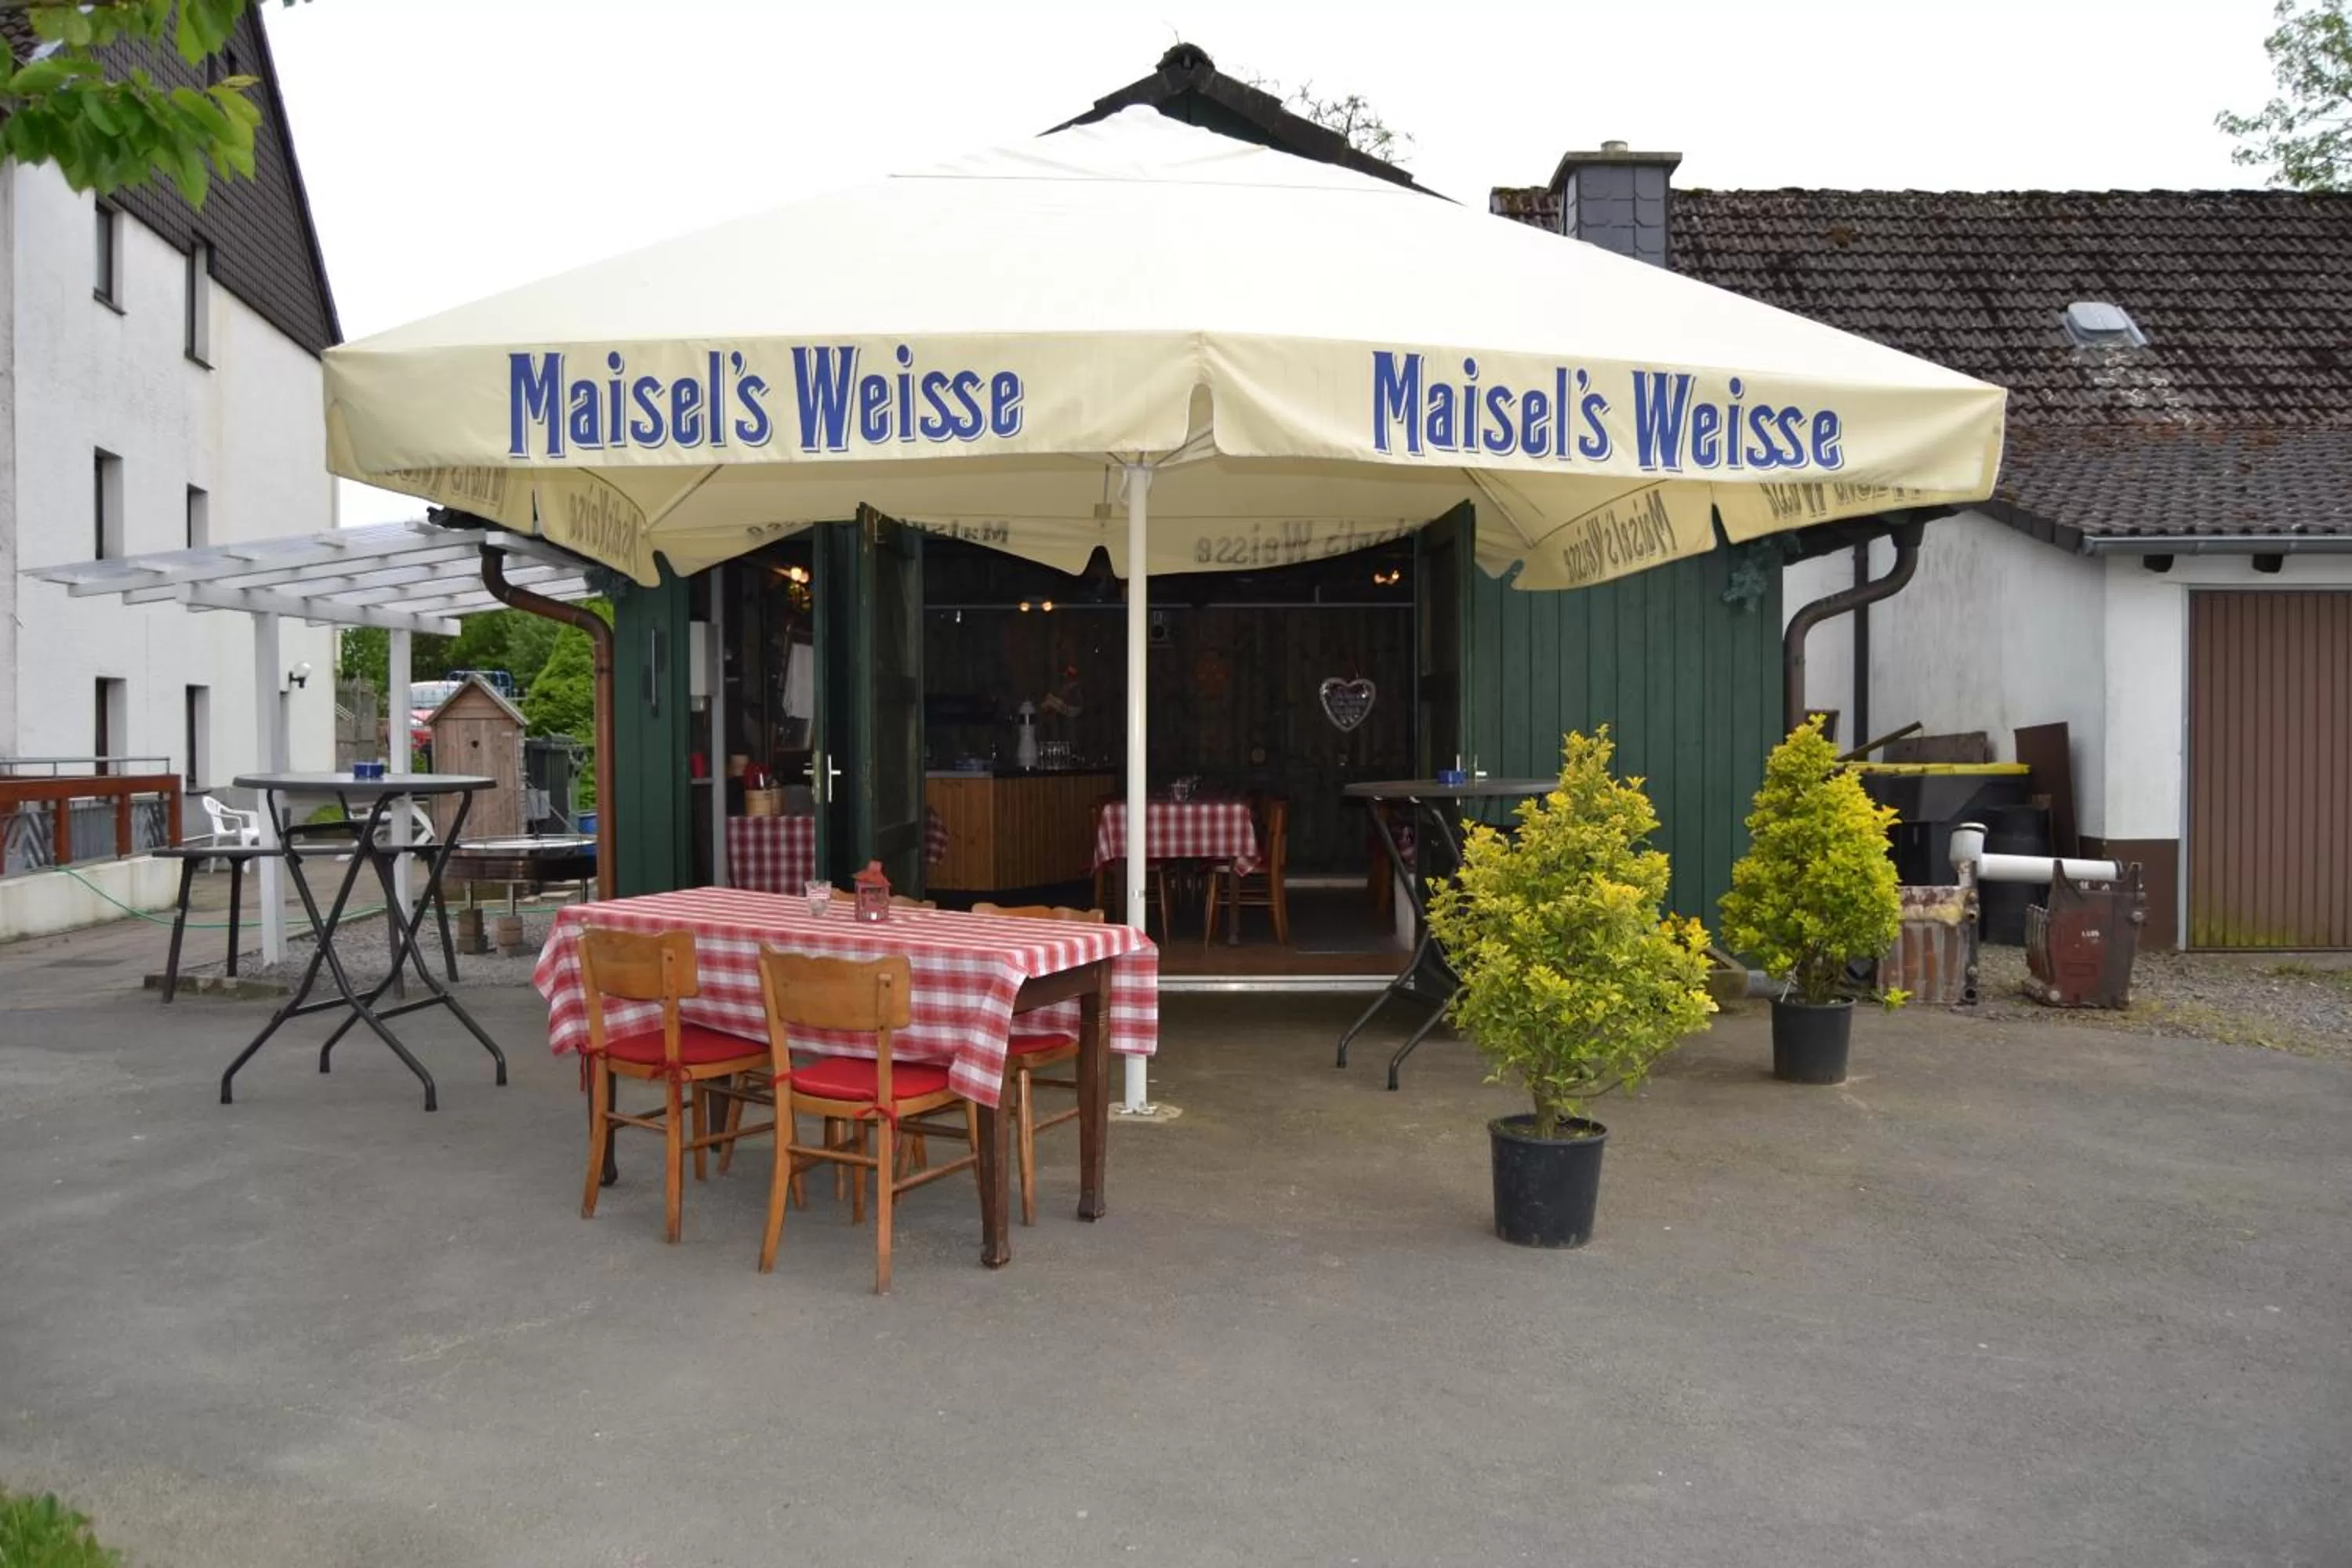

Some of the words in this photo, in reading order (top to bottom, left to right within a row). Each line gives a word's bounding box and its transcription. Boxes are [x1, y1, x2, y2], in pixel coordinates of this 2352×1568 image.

[508, 350, 772, 459] Maisel's
[790, 343, 1023, 452] Weisse
[1373, 350, 1613, 462] Maisel's
[1631, 370, 1845, 472] Weisse
